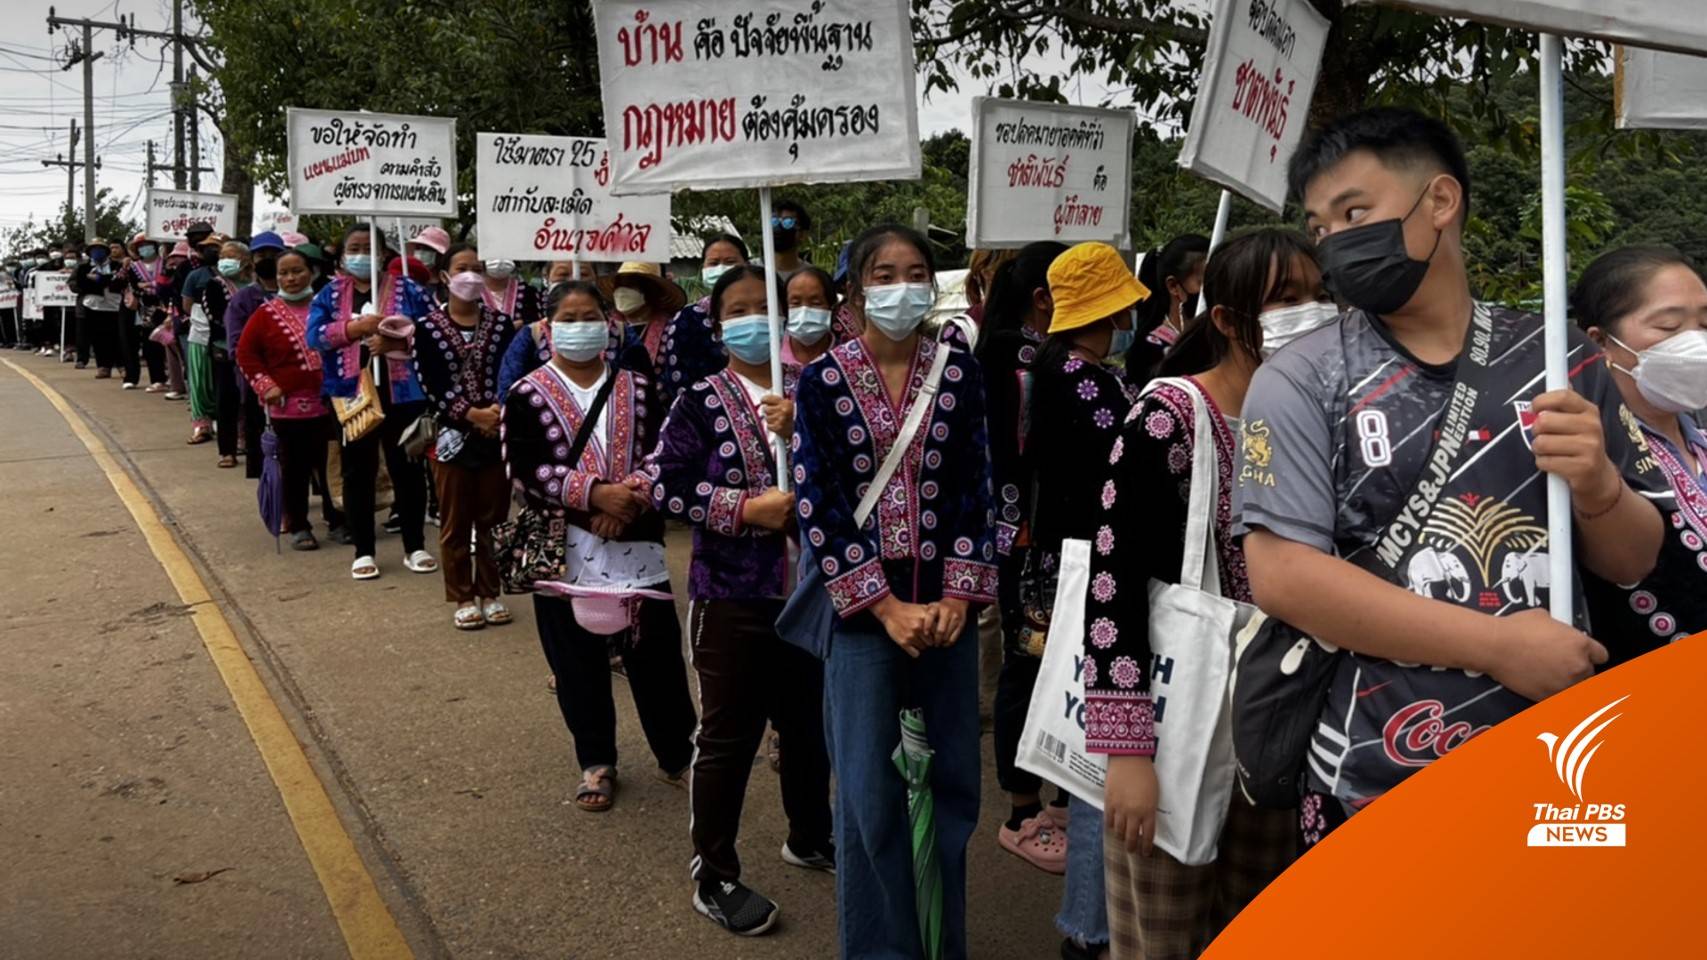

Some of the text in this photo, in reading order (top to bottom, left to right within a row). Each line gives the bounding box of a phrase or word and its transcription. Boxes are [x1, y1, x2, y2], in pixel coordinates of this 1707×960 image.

[617, 0, 873, 71] บ้าน คือ ปัจจัยพื้นฐาน
[310, 118, 417, 149] ขอให้จัดทำ
[742, 94, 880, 163] ต้องคุ้มครอง
[303, 146, 442, 181] แผนแม่บท ตามคำสั่ง
[493, 136, 598, 167] ใช้มาตรา 25
[333, 176, 447, 206] ผู้ตรวจการแผ่นดิน
[1093, 164, 1108, 191] คือ
[492, 186, 594, 215] เท่ากับละเมิด
[1053, 194, 1104, 235] ผู้ทำลาย
[533, 213, 652, 254] อำนาจศาล
[1443, 381, 1467, 436] LIMITED
[1452, 387, 1478, 446] EDITION
[1356, 409, 1392, 468] 8
